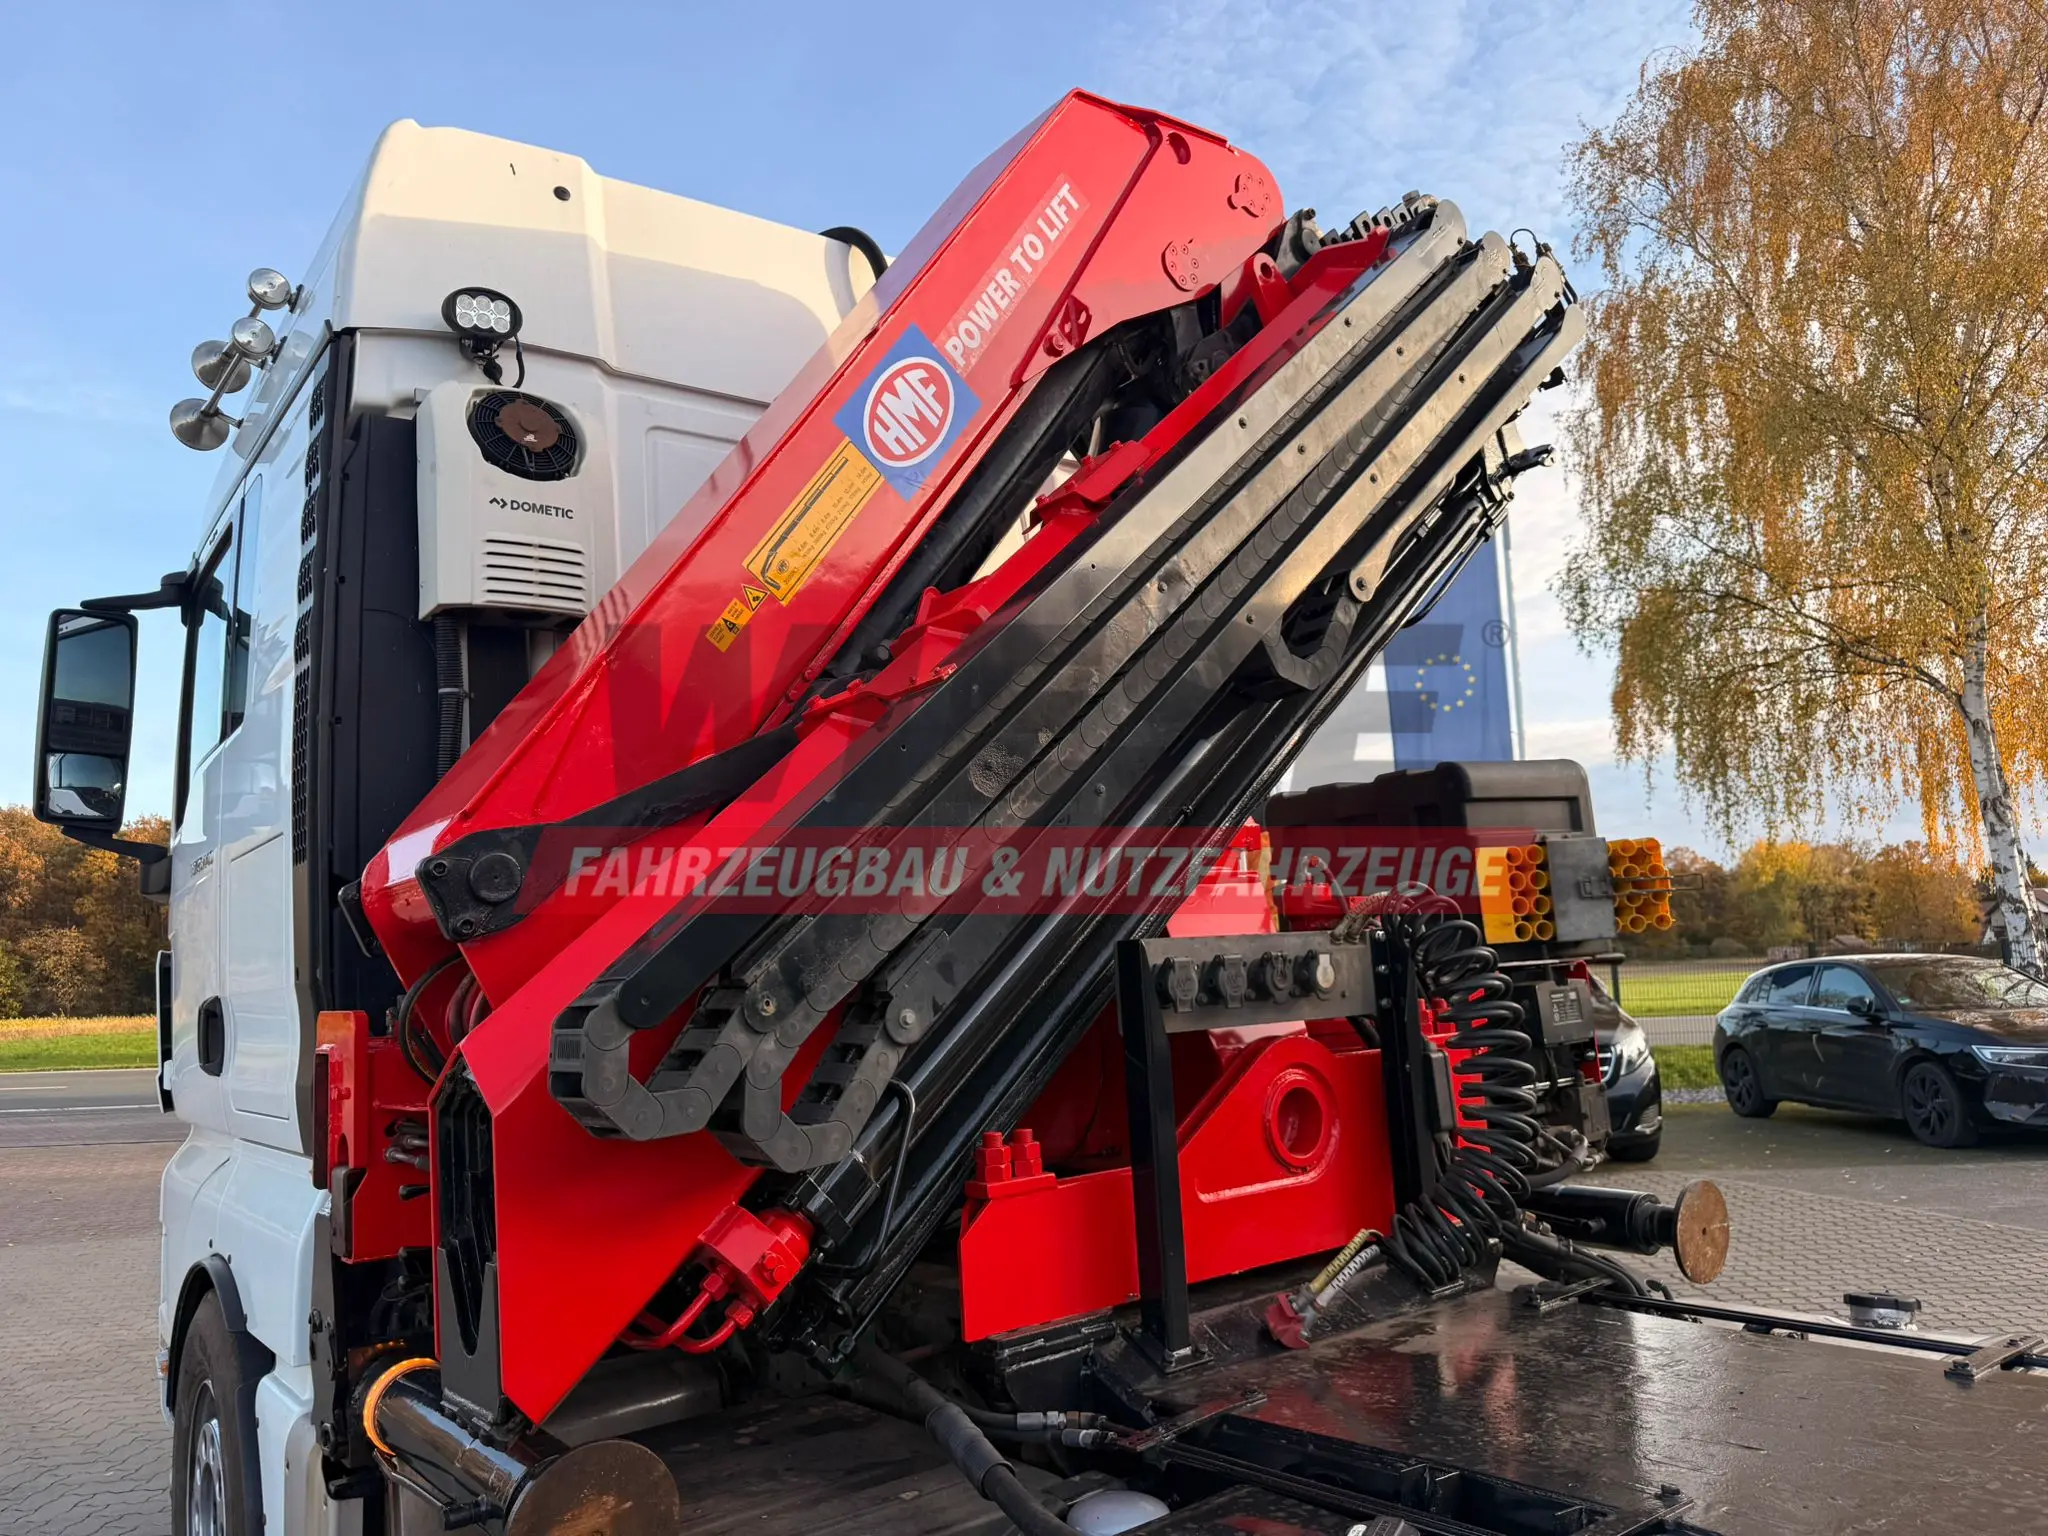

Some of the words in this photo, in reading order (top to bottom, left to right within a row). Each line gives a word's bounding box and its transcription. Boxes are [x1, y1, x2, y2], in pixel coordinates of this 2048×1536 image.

[944, 268, 1021, 368] POWER
[1009, 233, 1045, 274] TO
[1037, 182, 1080, 242] LIFT
[874, 368, 944, 456] HMF
[510, 499, 574, 520] DOMETIC
